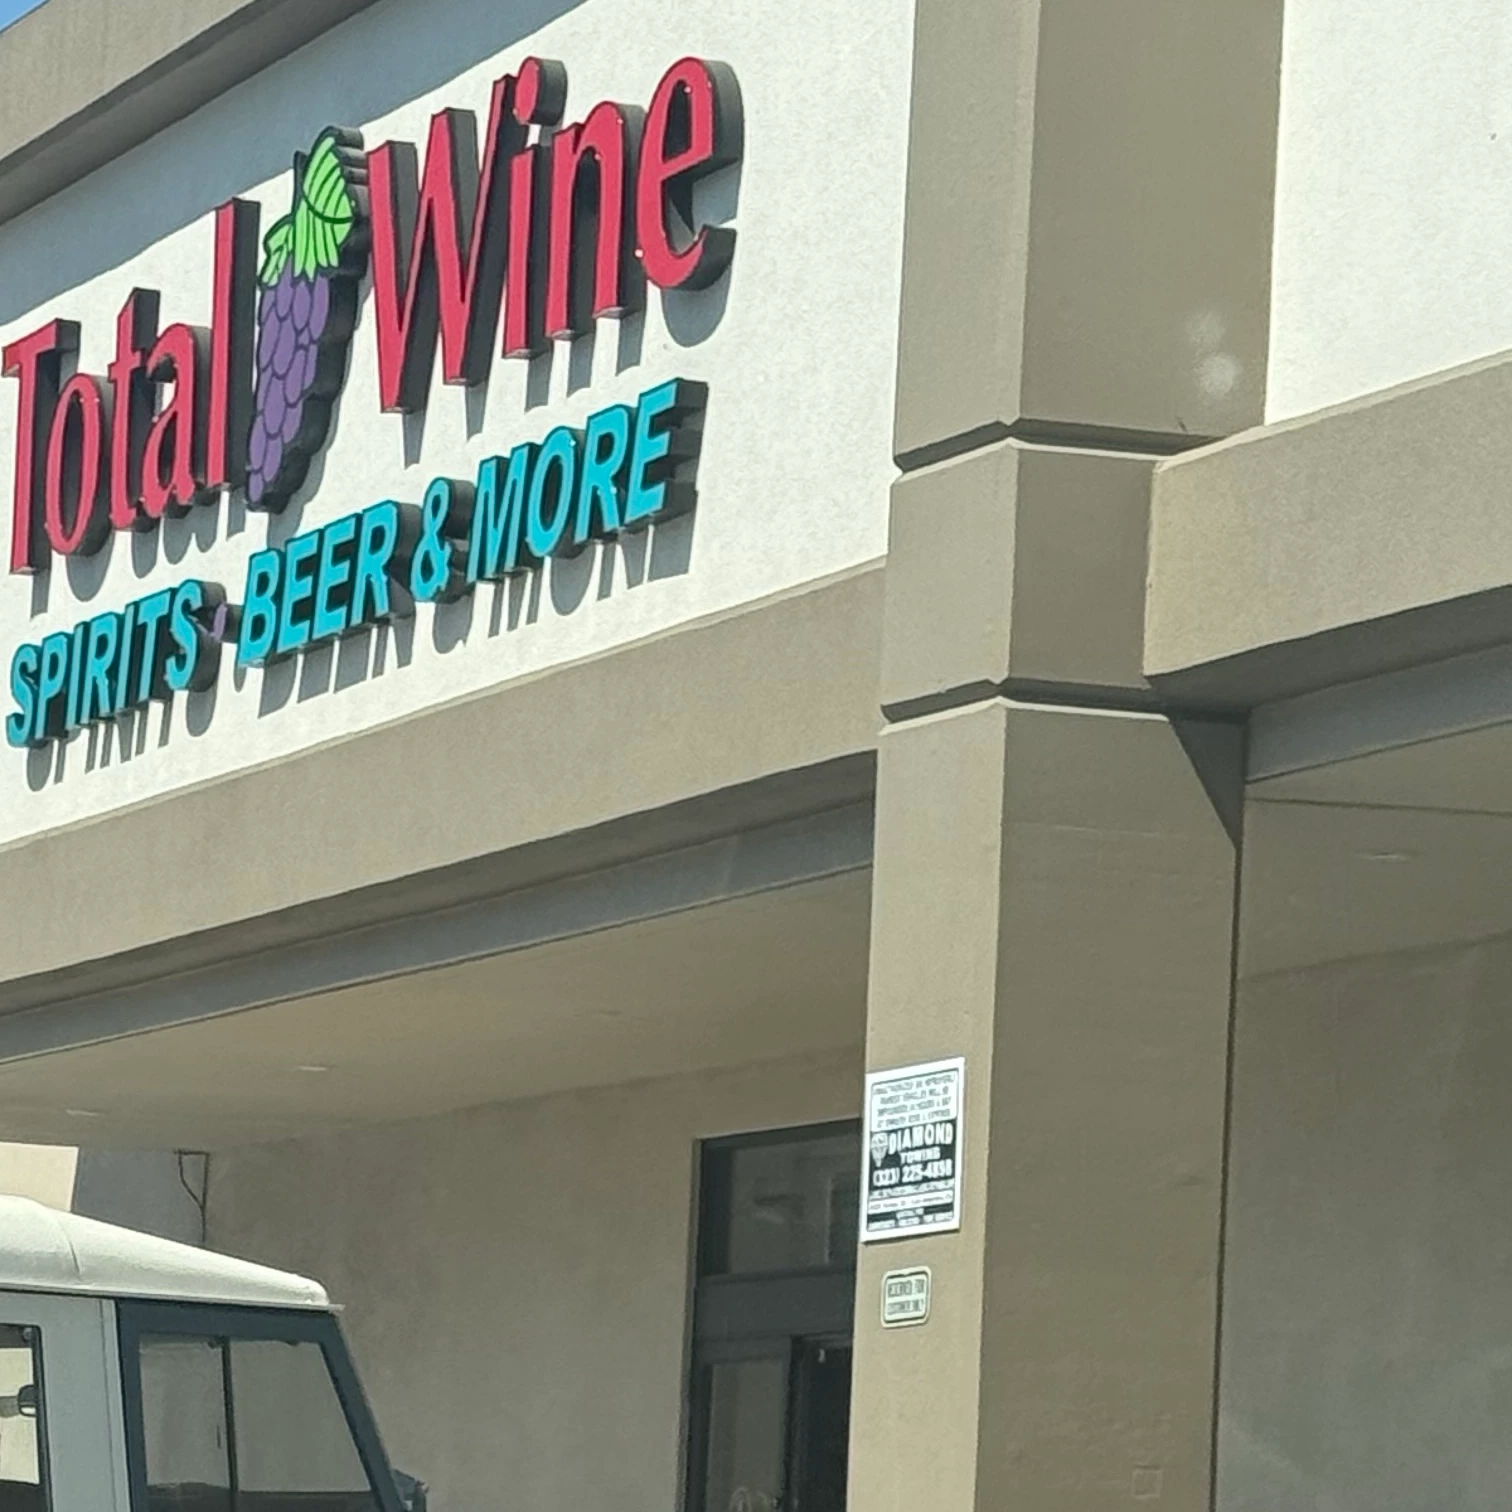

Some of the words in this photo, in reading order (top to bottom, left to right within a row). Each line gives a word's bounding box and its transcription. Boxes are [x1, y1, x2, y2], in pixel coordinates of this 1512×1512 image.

[2, 198, 256, 575] Total
[368, 56, 733, 413] Wine
[6, 580, 212, 747] SPIRITS
[238, 501, 408, 668] BEER
[410, 478, 462, 602] &
[472, 379, 694, 583] MORE
[888, 1122, 953, 1155] DIAMOND
[898, 1146, 941, 1165] TOWING
